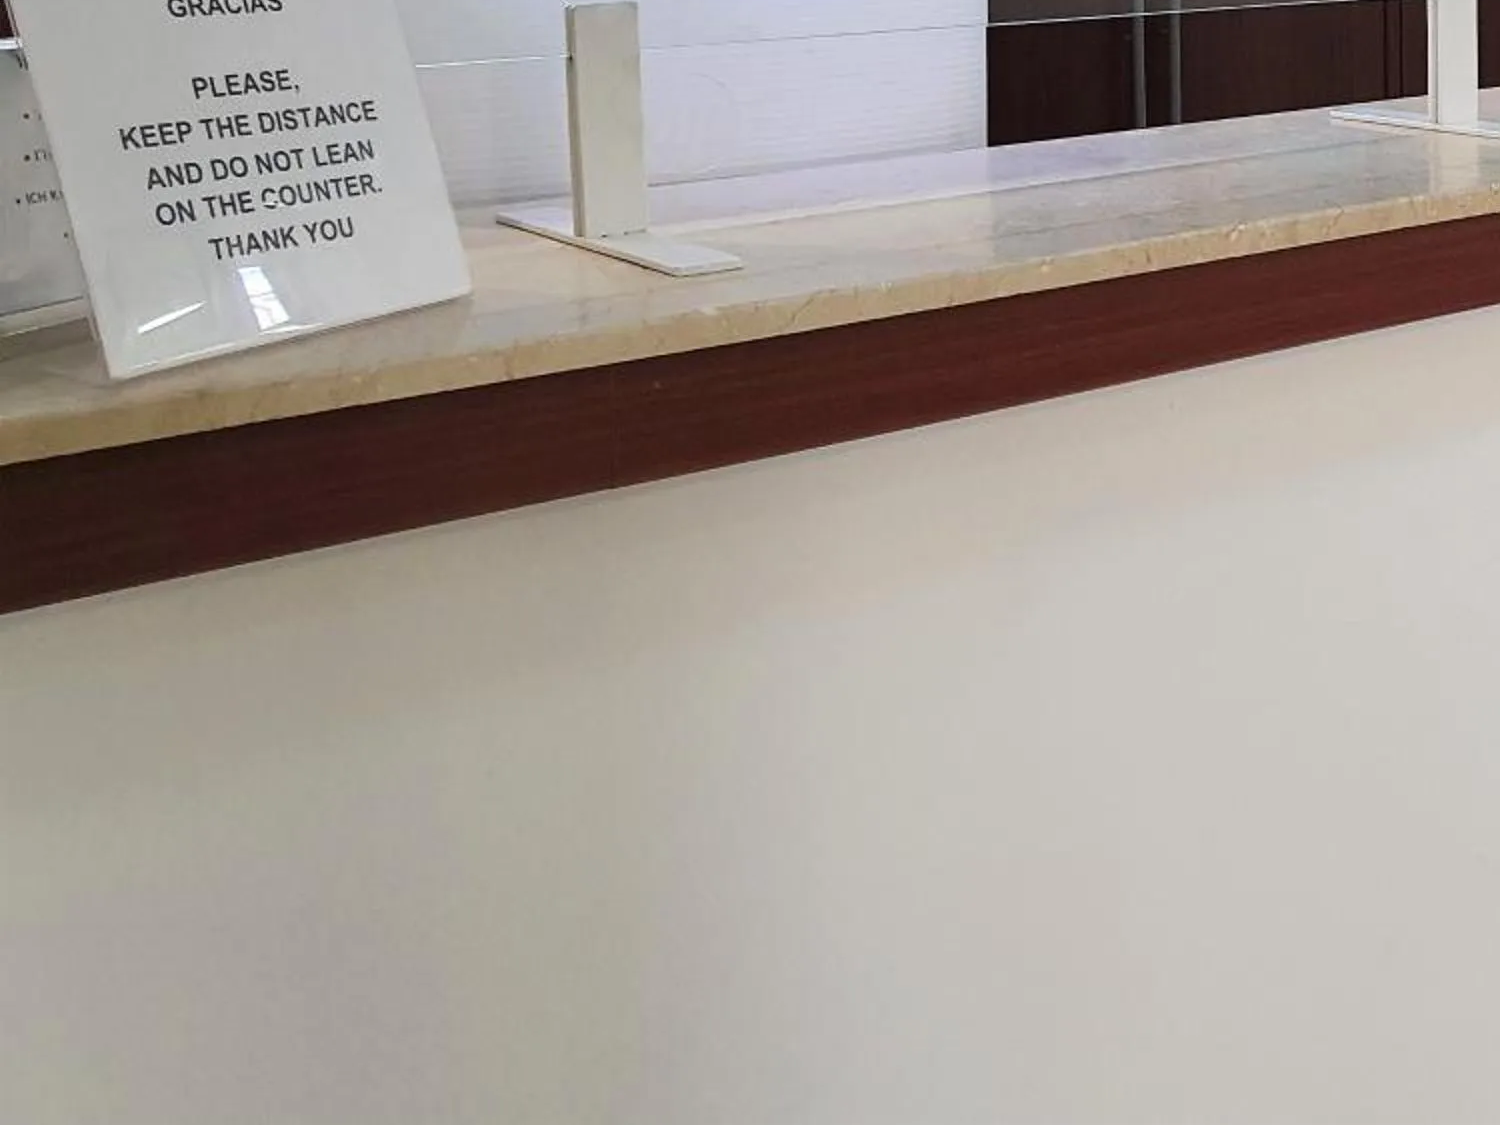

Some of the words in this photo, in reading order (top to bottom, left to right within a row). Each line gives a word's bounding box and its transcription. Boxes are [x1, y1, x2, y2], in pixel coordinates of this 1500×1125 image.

[191, 69, 299, 100] PLEASE,
[119, 121, 192, 151] KEEP
[198, 116, 253, 140] THE
[257, 100, 378, 134] DISTANCE
[147, 162, 203, 191] AND
[209, 156, 249, 181] DO
[254, 148, 304, 175] NOT
[311, 139, 374, 168] LEAN
[155, 199, 197, 226] ON
[201, 192, 256, 219] THE
[260, 173, 383, 210] COUNTER.
[207, 226, 299, 261] THANK
[302, 216, 354, 244] YOU
